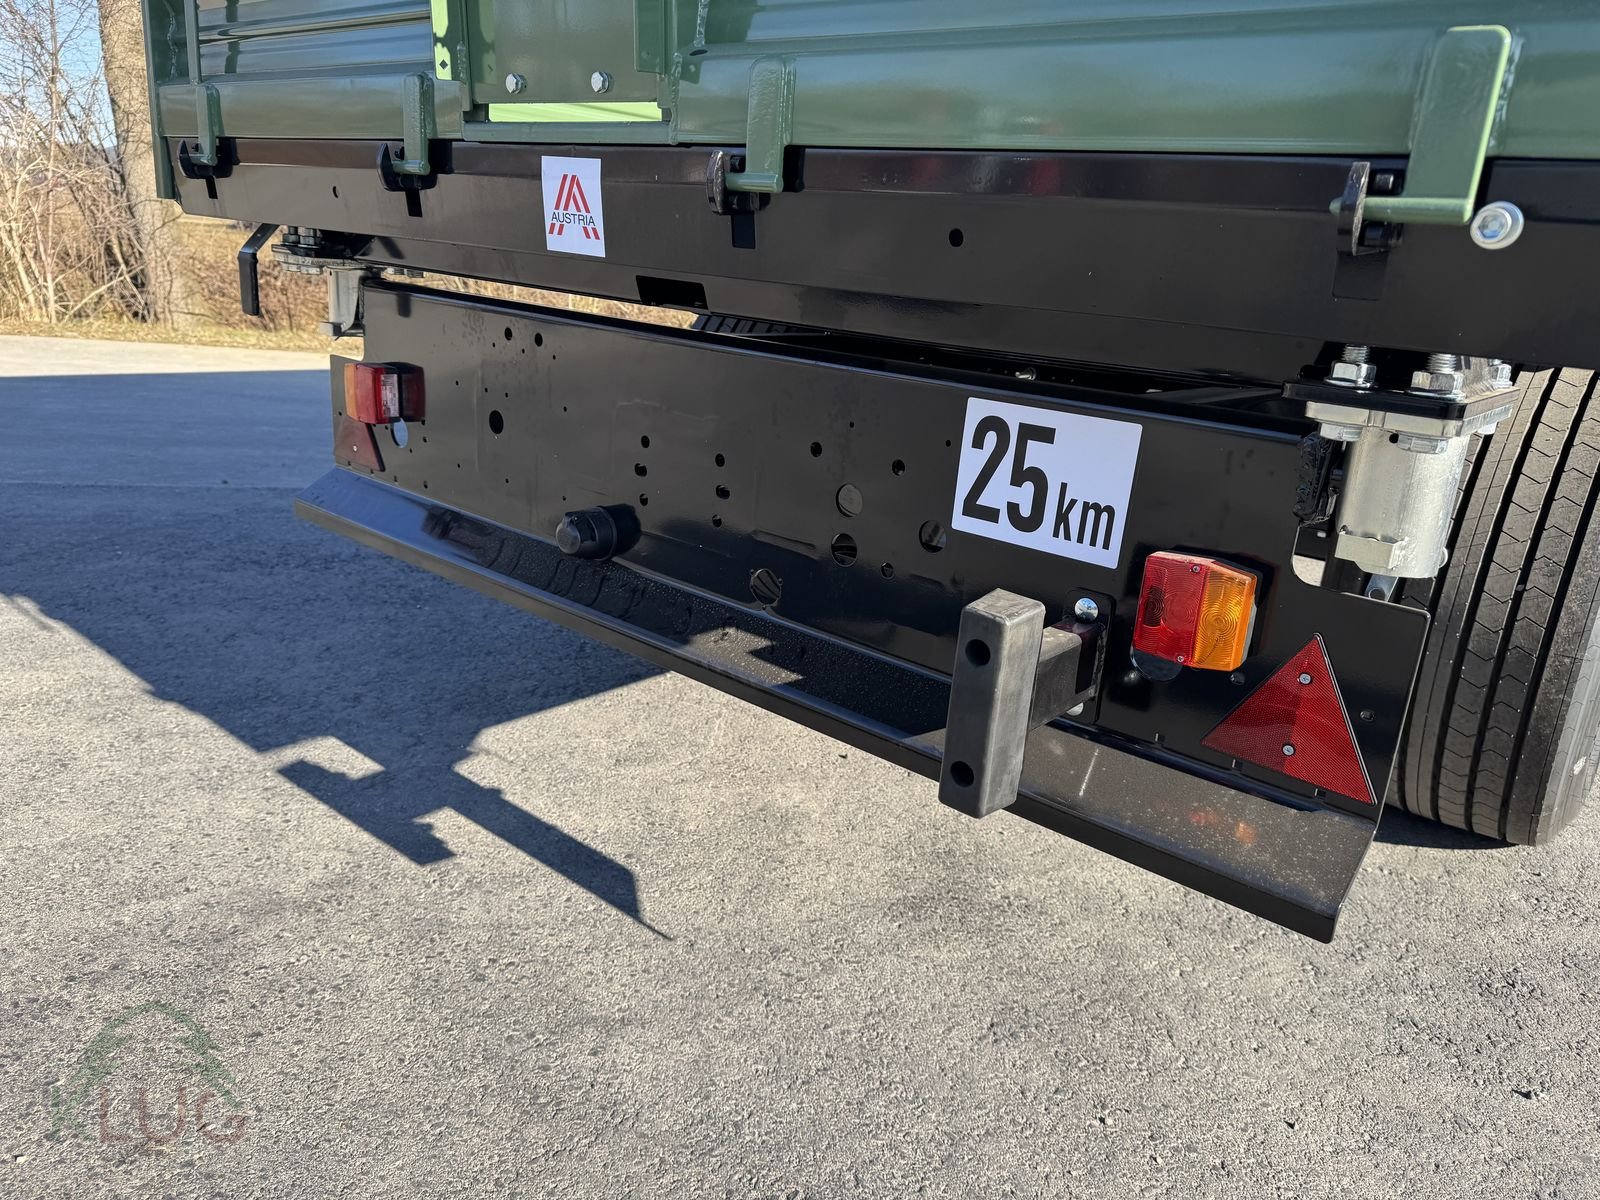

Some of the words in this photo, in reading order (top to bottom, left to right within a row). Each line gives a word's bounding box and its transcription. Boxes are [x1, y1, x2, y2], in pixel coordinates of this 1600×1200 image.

[551, 211, 596, 226] AUSTRIA
[961, 415, 1057, 533] 25
[1052, 481, 1116, 551] km
